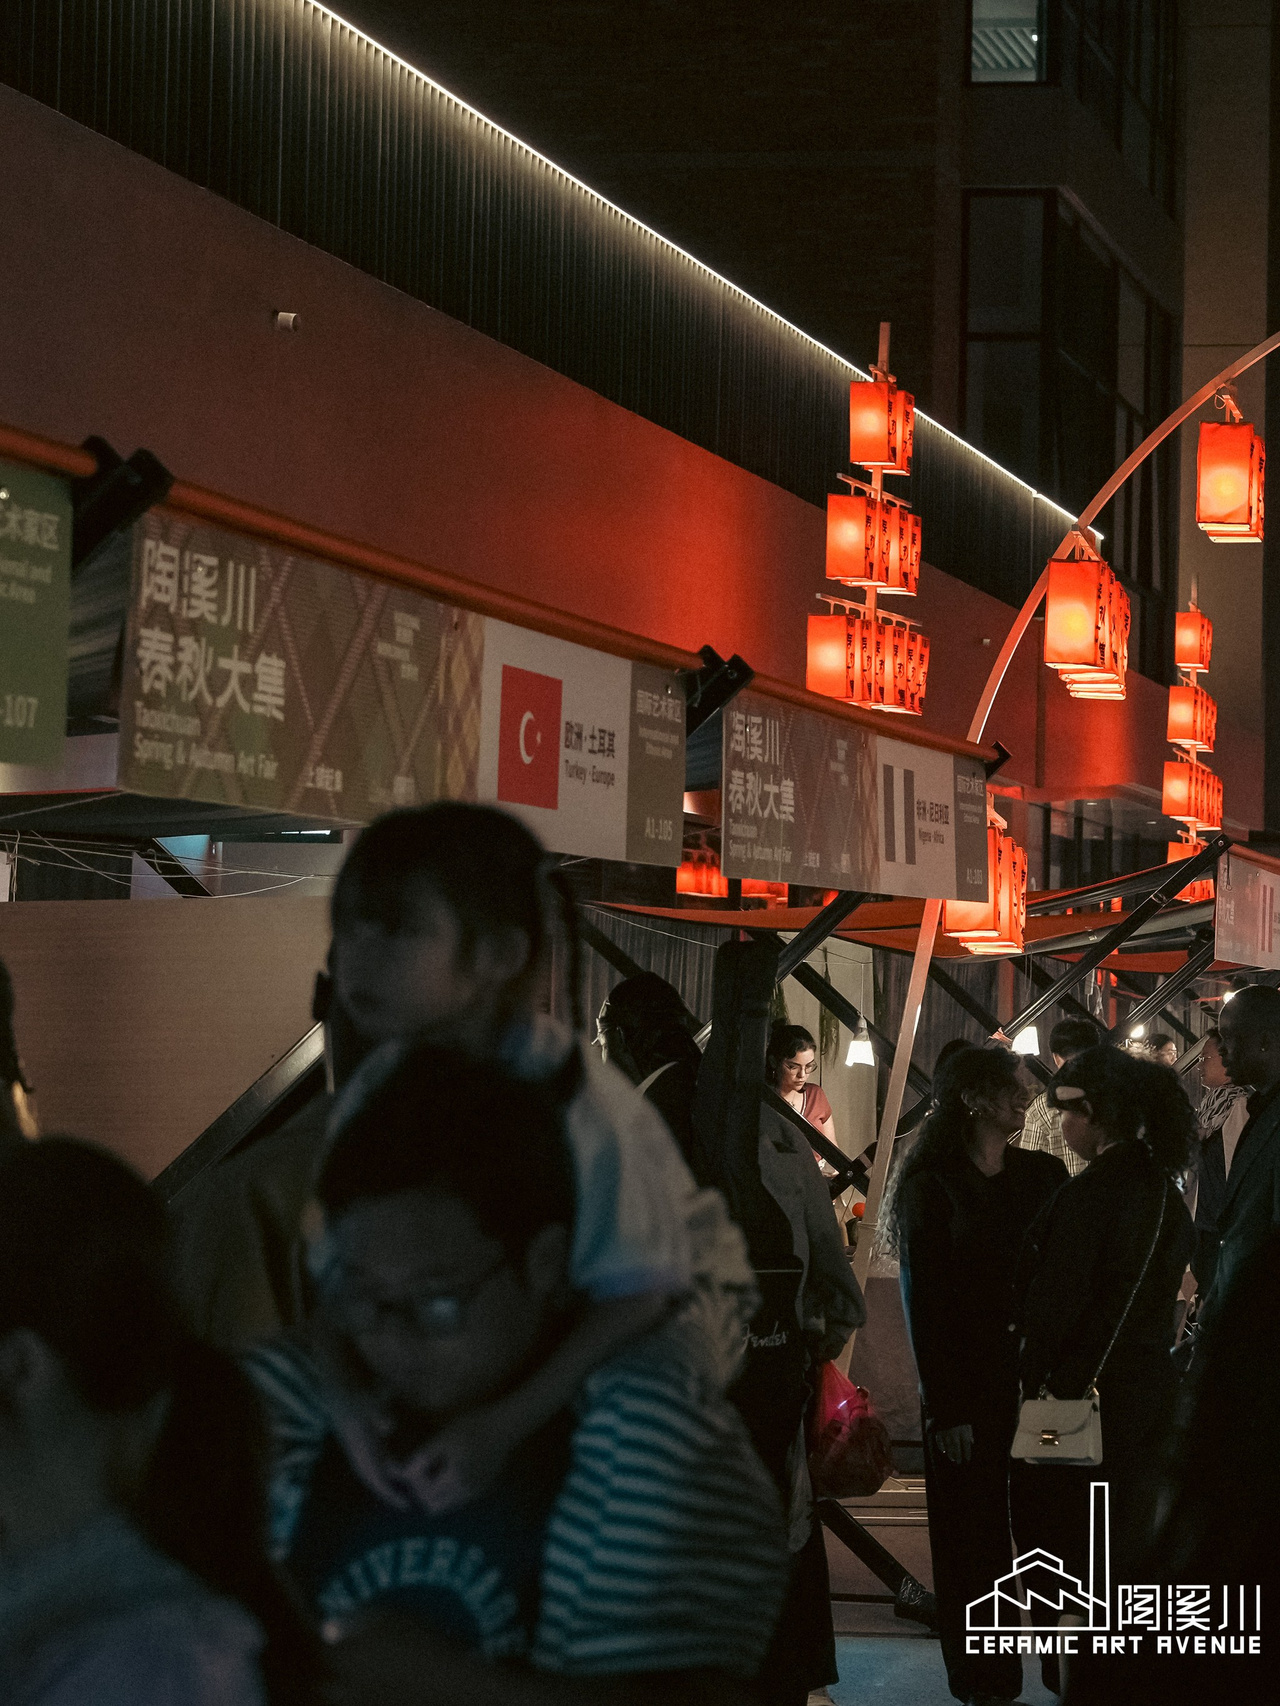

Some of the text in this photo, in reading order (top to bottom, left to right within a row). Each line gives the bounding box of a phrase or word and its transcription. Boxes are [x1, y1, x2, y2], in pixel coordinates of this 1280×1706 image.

[0, 503, 59, 550] 术家区
[142, 538, 257, 632] 陶溪川
[136, 626, 286, 722] 春秋大集
[134, 732, 174, 770] Spring
[731, 710, 780, 766] 陶溪川
[565, 759, 587, 785] Turkey
[592, 765, 616, 790] Europe
[729, 768, 794, 823] 春秋大集
[741, 1320, 788, 1353] Fender
